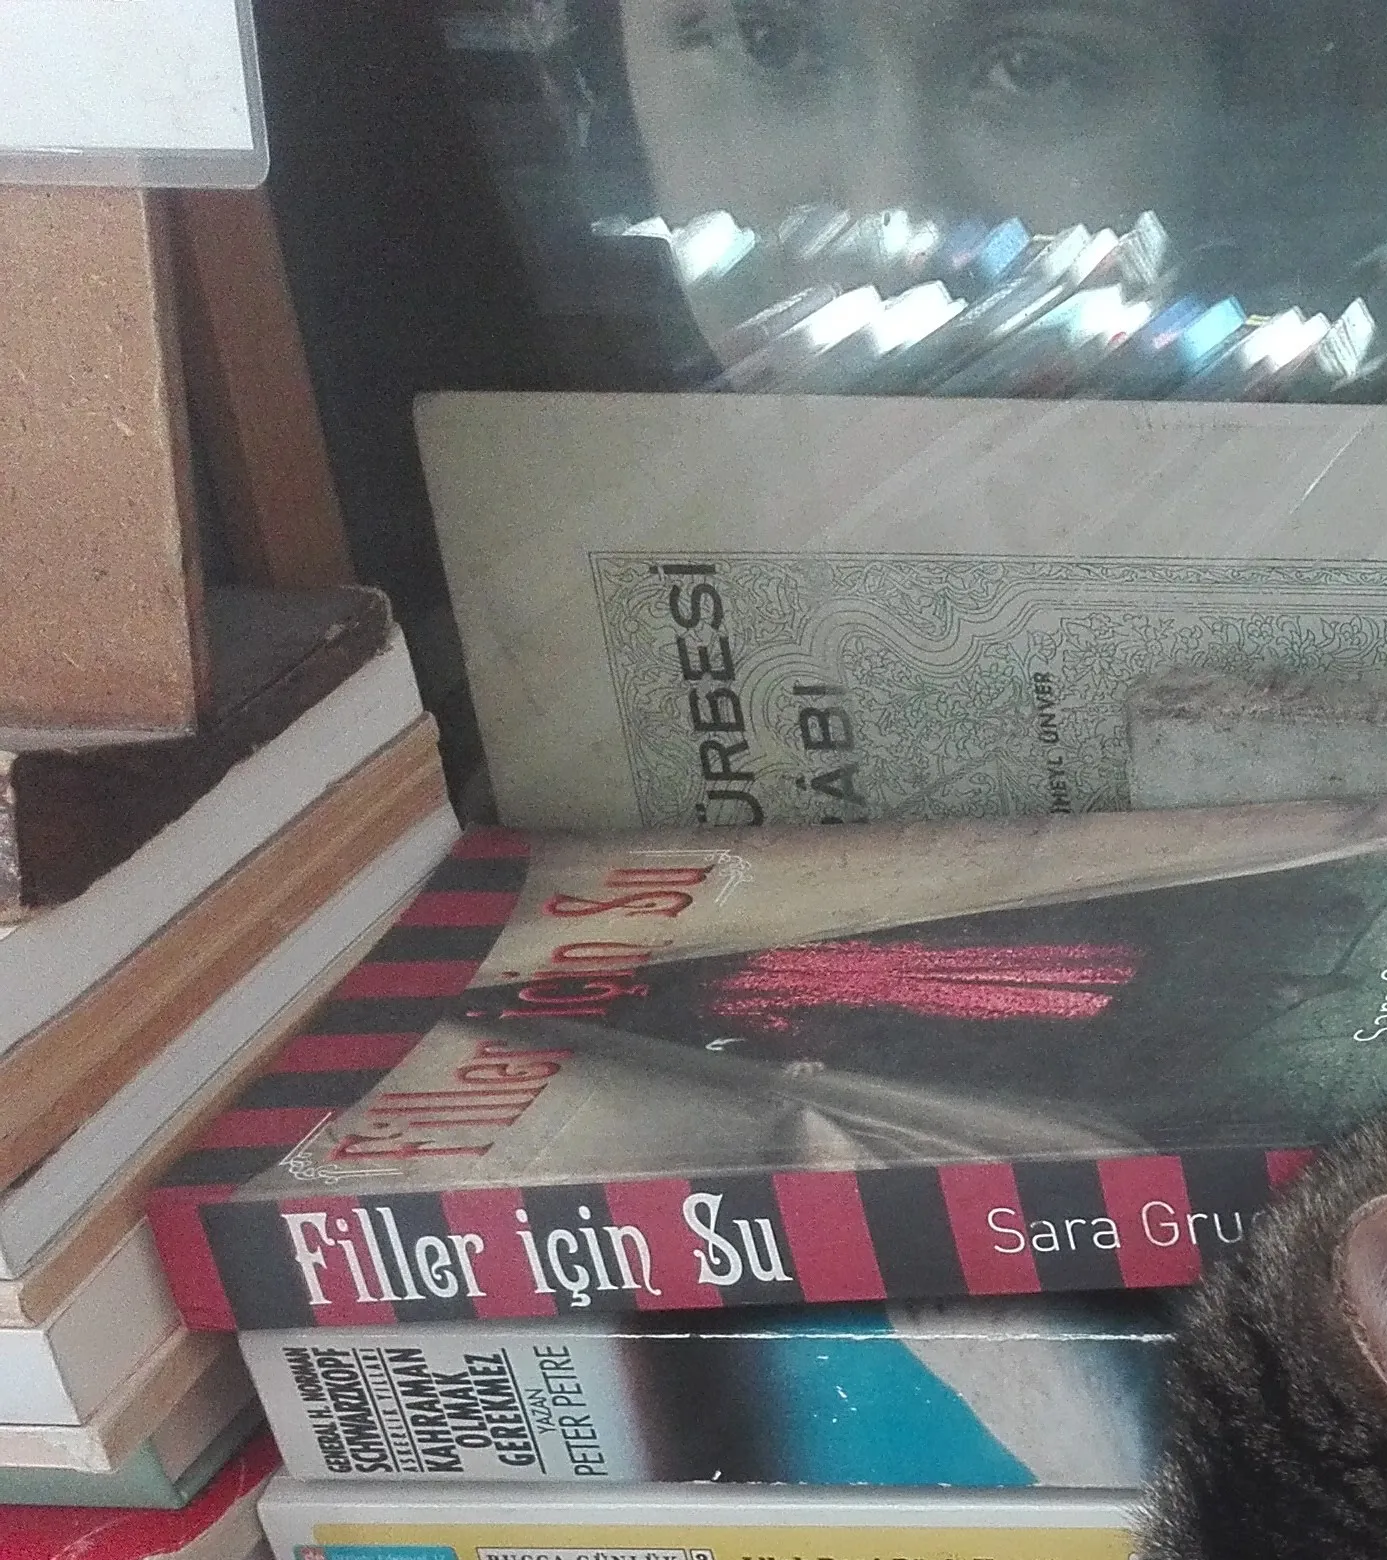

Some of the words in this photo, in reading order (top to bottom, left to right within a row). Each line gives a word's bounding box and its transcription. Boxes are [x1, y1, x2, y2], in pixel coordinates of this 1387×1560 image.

[544, 864, 717, 918] Su
[465, 939, 654, 1019] için
[328, 1040, 575, 1161] Filler
[280, 1207, 486, 1306] Filler
[515, 1213, 662, 1307] için
[681, 1192, 794, 1287] Su
[986, 1208, 1121, 1254] Sara
[282, 1347, 327, 1402] NORMAN
[432, 1371, 493, 1448] OLMAK
[533, 1346, 588, 1408] PETRE
[311, 1347, 393, 1473] SCHWARZKOPF
[385, 1348, 464, 1473] KAHRAMAN
[464, 1353, 535, 1467] GEREKMEZ
[525, 1389, 556, 1434] YAZAN
[312, 1423, 352, 1473] GENERAL
[559, 1414, 608, 1477] PETER
